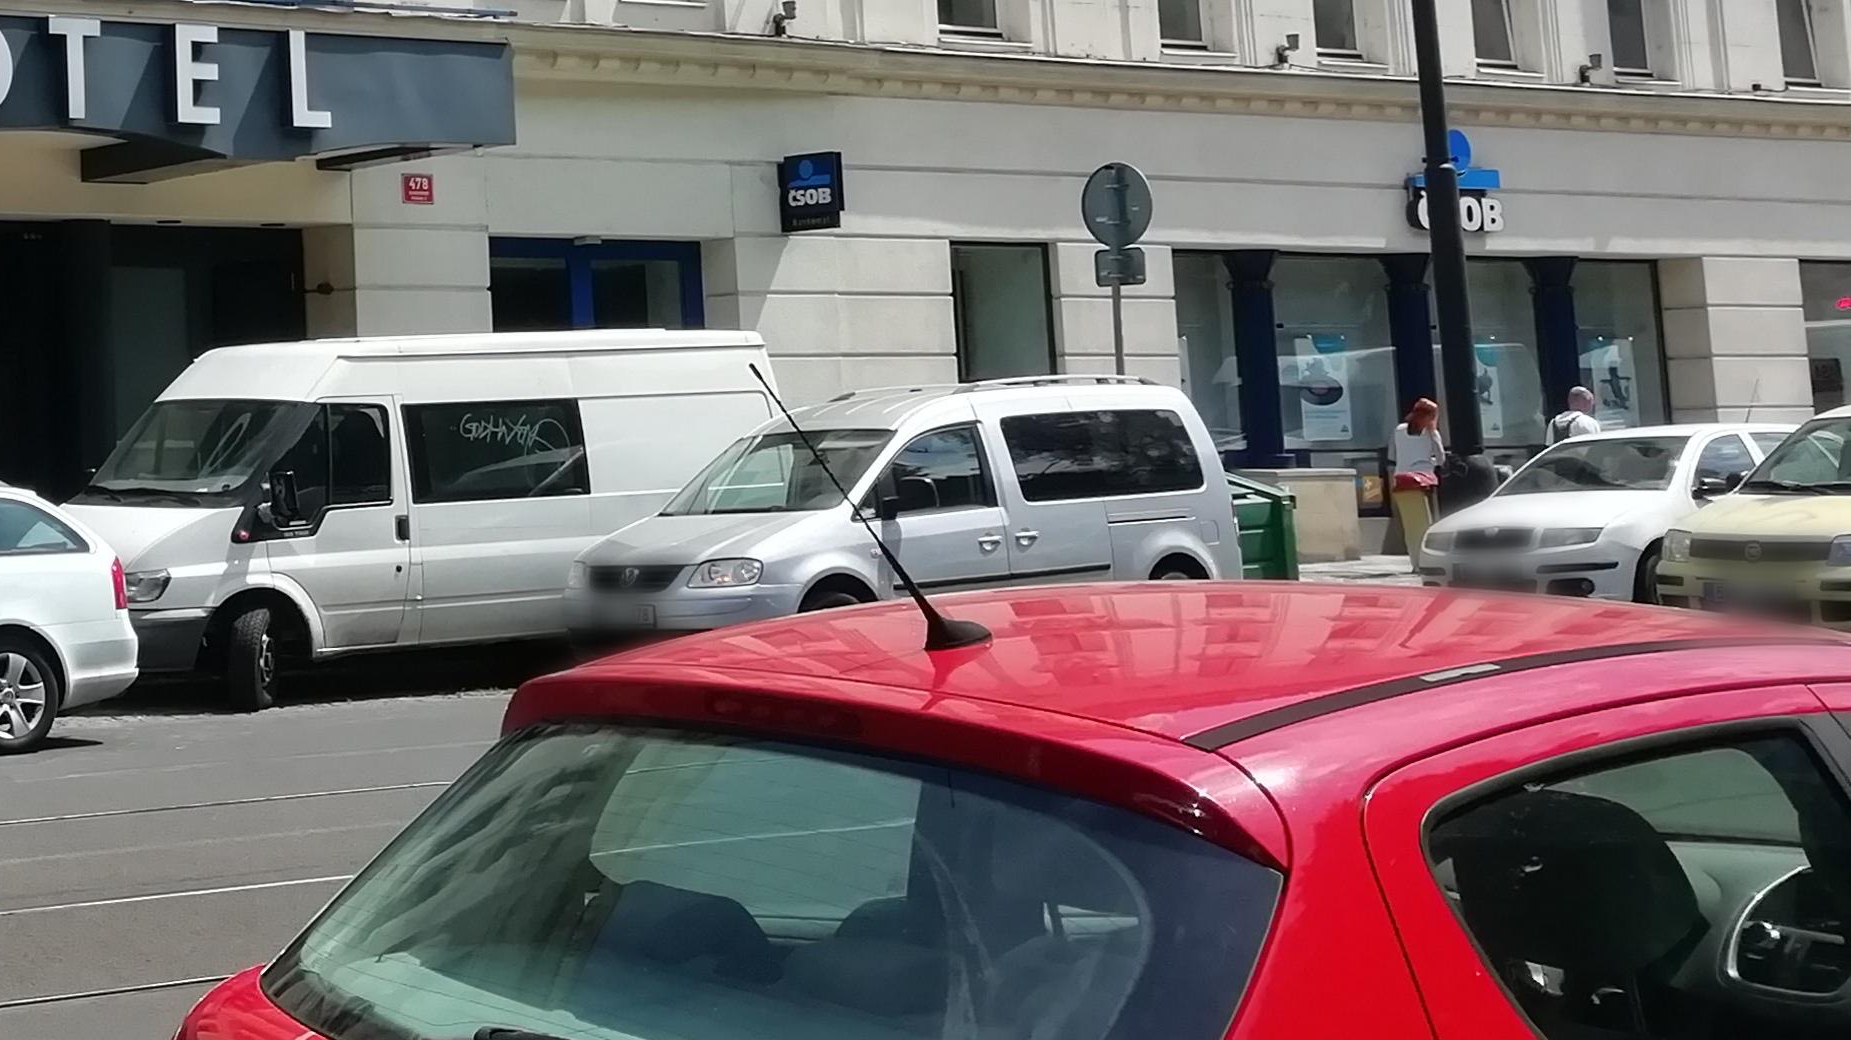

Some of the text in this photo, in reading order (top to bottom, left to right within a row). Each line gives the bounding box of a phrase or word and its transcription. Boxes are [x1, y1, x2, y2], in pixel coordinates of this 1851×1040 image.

[408, 177, 429, 190] 478
[787, 187, 832, 207] ČSOB
[1417, 190, 1505, 232] OB
